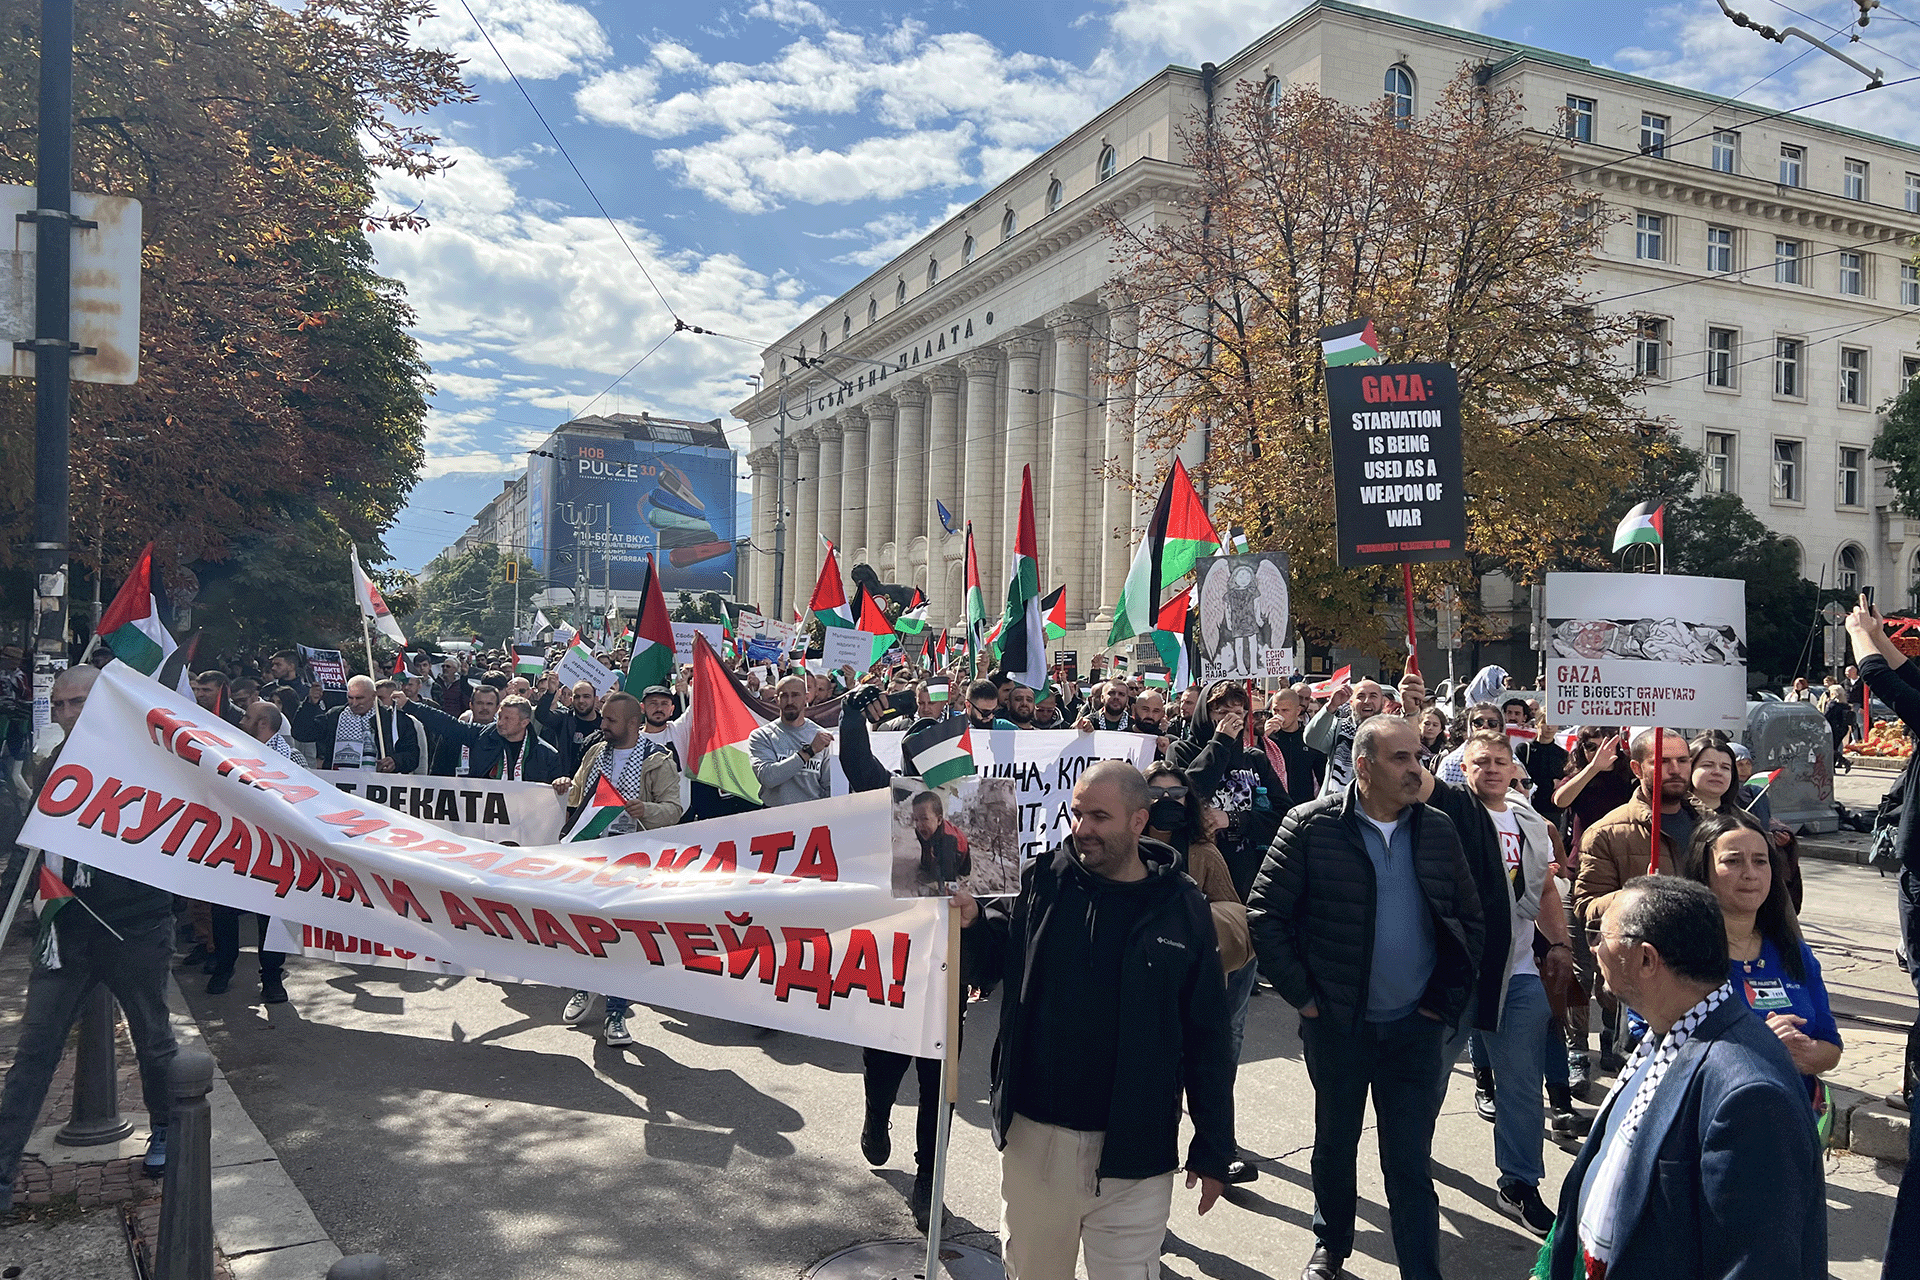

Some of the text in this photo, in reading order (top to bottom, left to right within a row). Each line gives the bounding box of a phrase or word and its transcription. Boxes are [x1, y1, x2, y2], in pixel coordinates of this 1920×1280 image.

[818, 318, 973, 411] СЪДЕБНА ПАЛАТА
[1362, 374, 1433, 403] GAZA:
[1352, 410, 1441, 430] STARVATION
[1369, 435, 1430, 454] IS BEING
[641, 466, 656, 476] 3.0
[1364, 459, 1437, 479] USED AS A
[1360, 483, 1443, 504] WEAPON OF
[1387, 509, 1422, 527] WAR
[626, 535, 650, 543] ВКУС
[1558, 666, 1601, 683] GAZA
[1558, 685, 1696, 701] THE BIGGEST GRAVEYARD
[1558, 700, 1656, 717] OF CHILDREN!
[146, 706, 233, 765] НЕ
[217, 757, 320, 804] НА
[365, 783, 510, 825] РЕКАТА
[37, 763, 911, 1010] ОКУПАЦИЯ И АПАРТЕЙДА!
